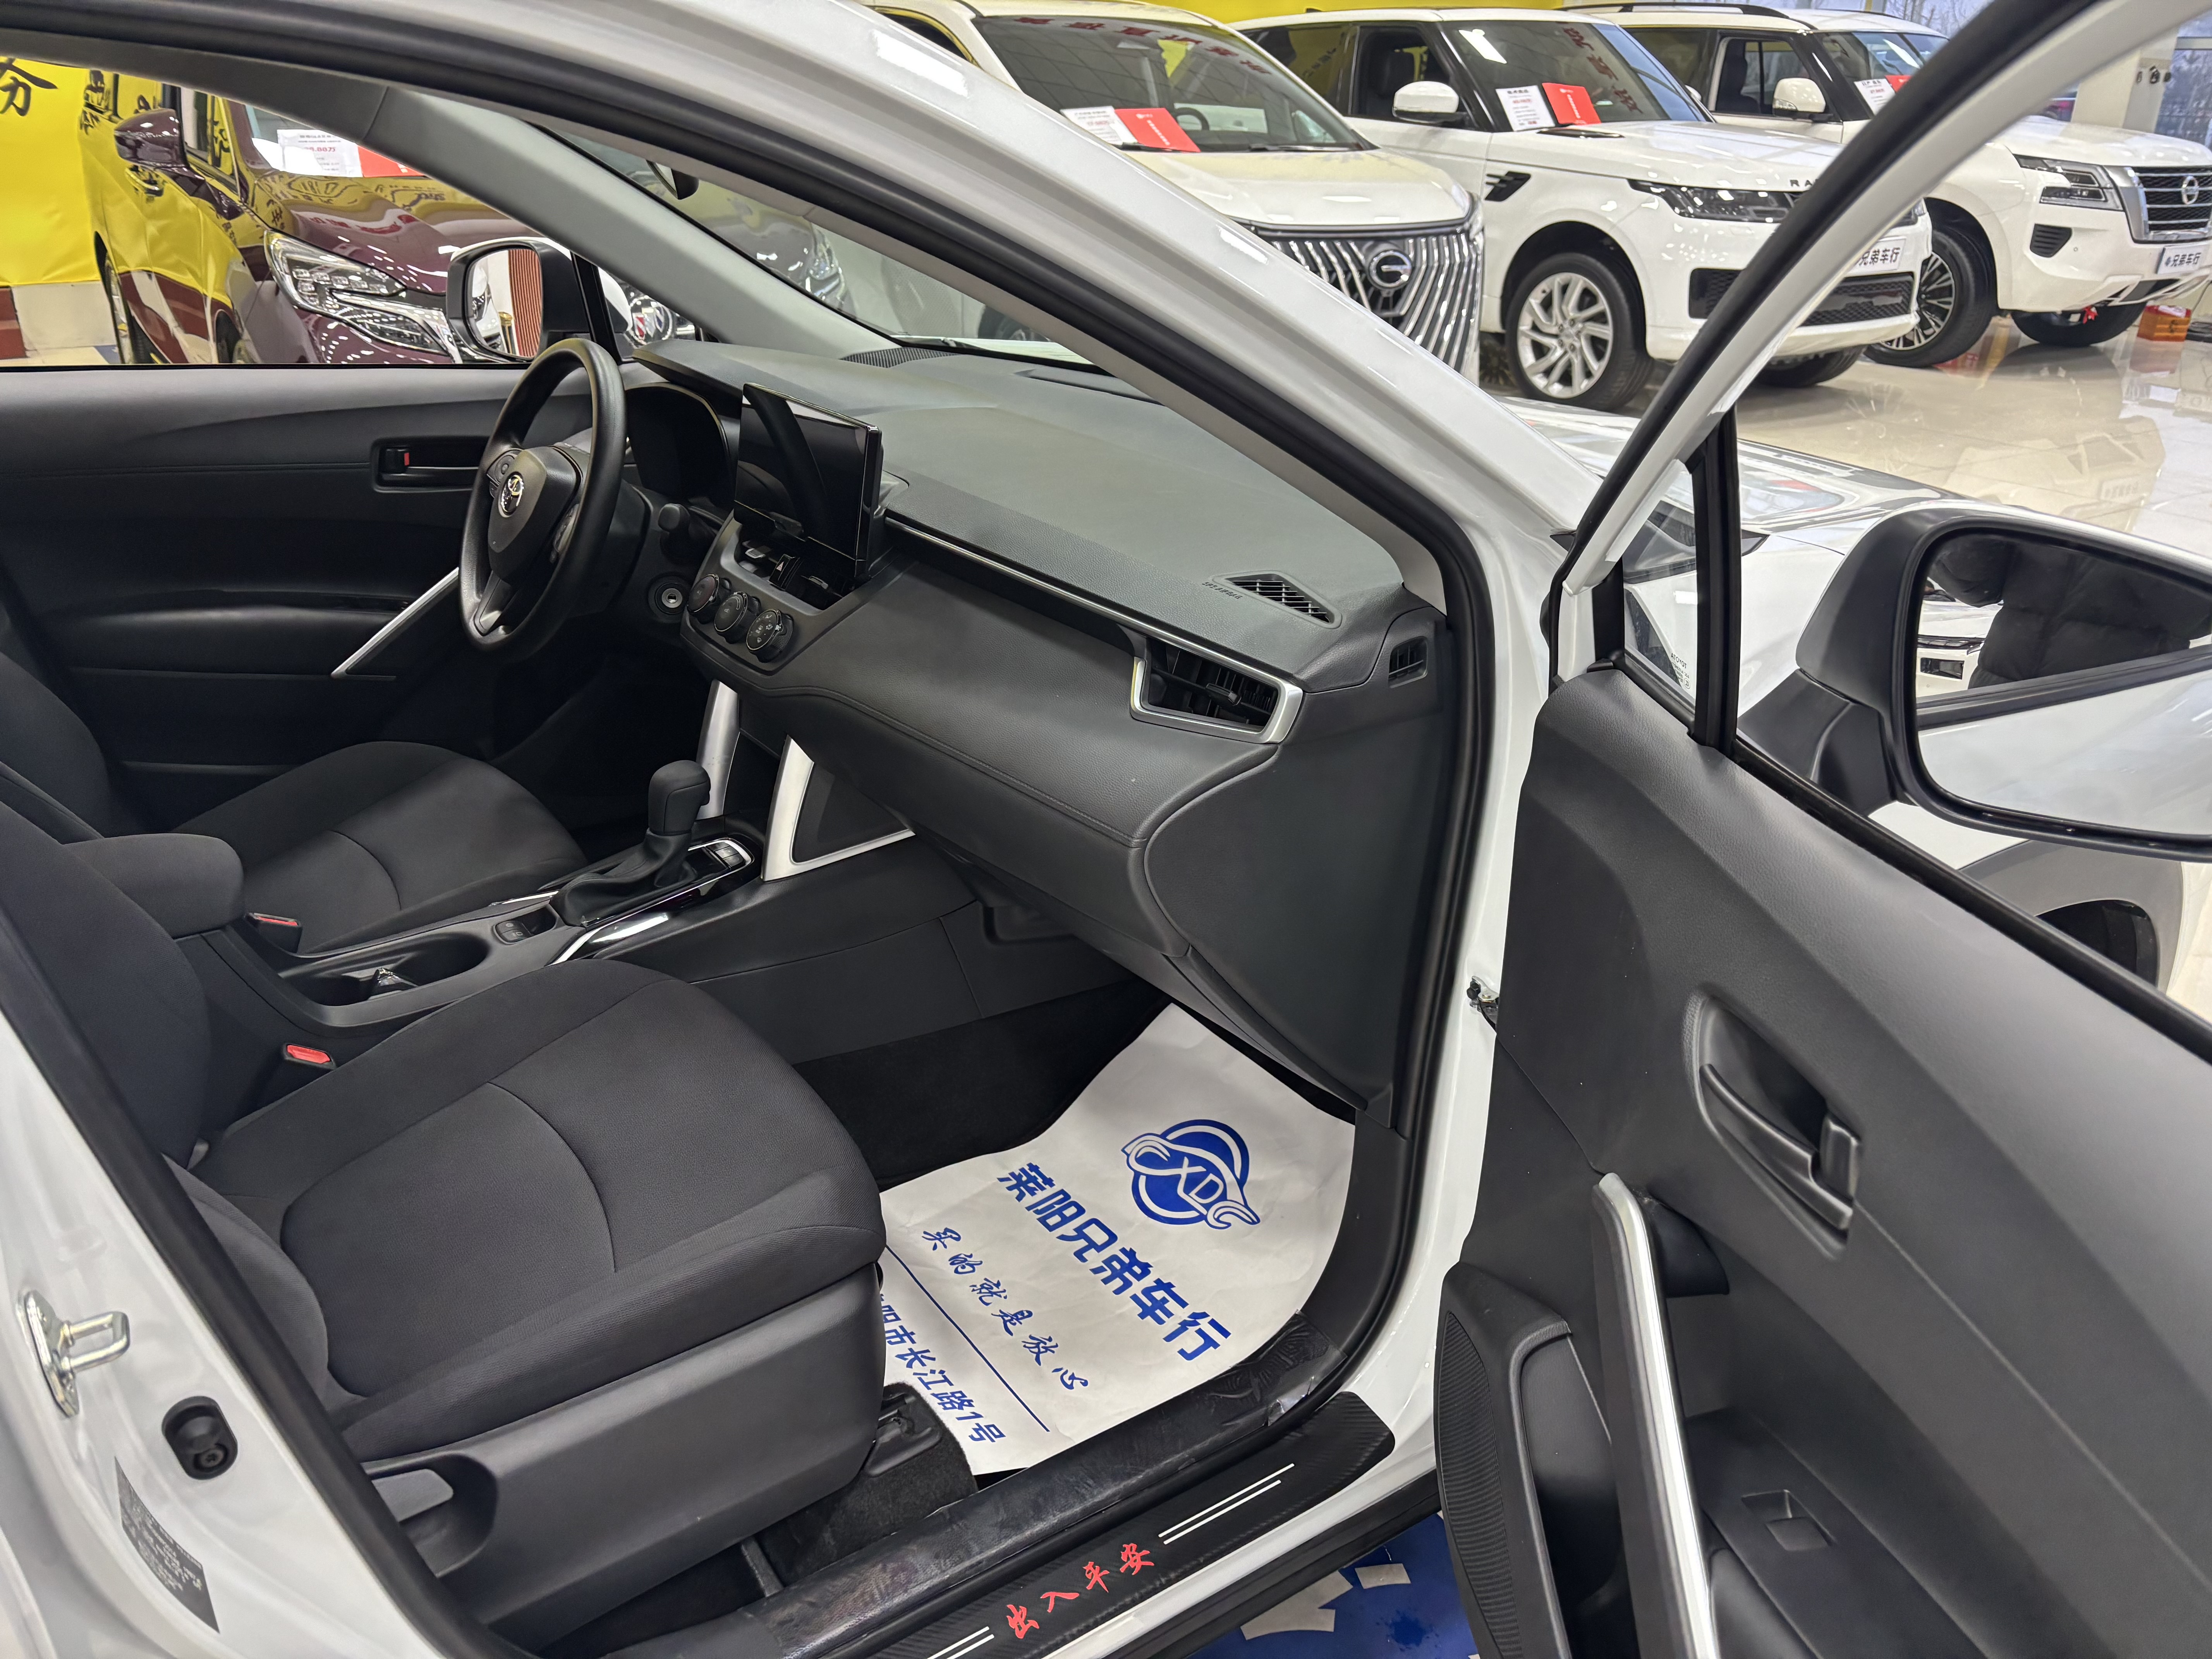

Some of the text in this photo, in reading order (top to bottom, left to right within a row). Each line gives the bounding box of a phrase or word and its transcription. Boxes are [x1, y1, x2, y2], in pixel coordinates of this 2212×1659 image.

[1859, 247, 1900, 265] 兄弟车行
[2171, 252, 2201, 266] 兄弟车行
[921, 1227, 1089, 1391] 买的就是放心
[996, 1163, 1231, 1361] 莱阳兄弟车行
[880, 1293, 1006, 1443] 阳市长江路1号
[1006, 1543, 1155, 1639] 出入平安
